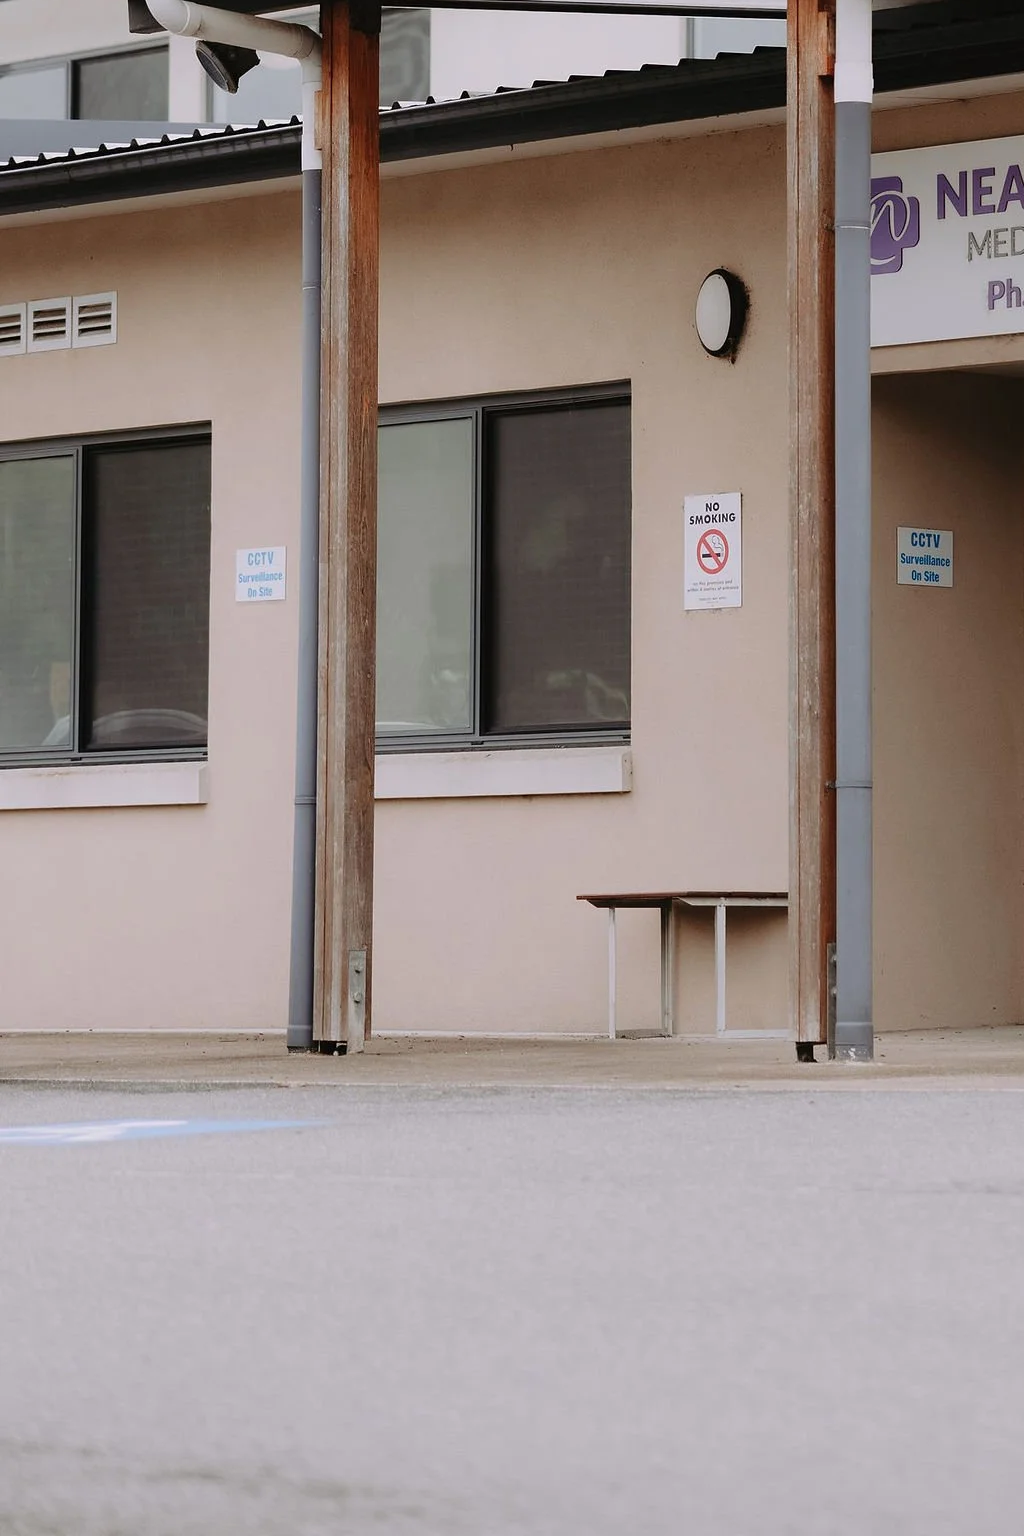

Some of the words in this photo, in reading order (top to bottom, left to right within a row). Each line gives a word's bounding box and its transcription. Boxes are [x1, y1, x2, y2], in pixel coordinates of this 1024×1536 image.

[705, 502, 720, 512] NO
[689, 513, 736, 525] SMOKING
[911, 532, 940, 548] CCTV
[248, 551, 274, 566] CCTV
[901, 553, 950, 567] Surveillance
[238, 572, 283, 583] Surveillance
[911, 570, 922, 581] On
[924, 570, 939, 582] Site
[247, 587, 257, 598] On
[259, 586, 272, 596] Site
